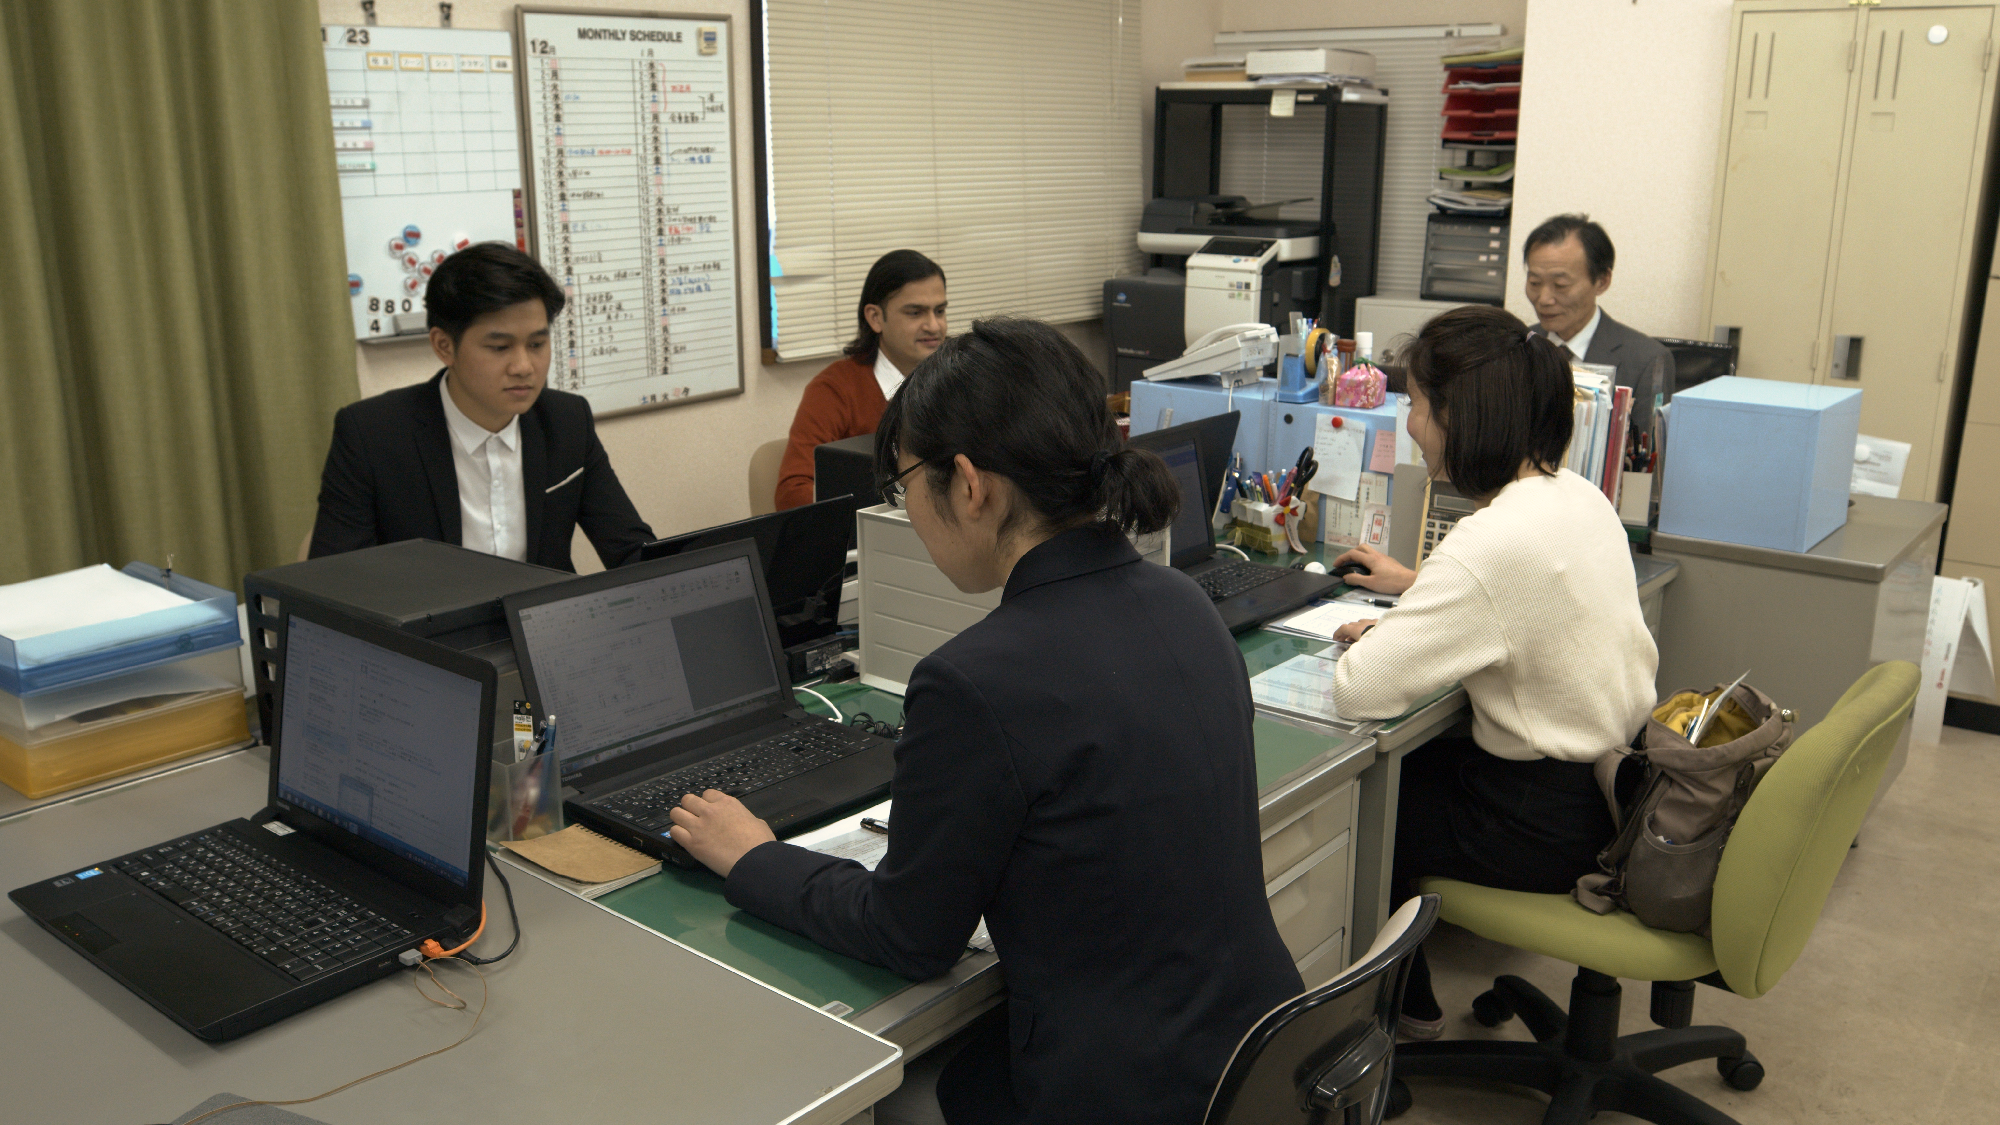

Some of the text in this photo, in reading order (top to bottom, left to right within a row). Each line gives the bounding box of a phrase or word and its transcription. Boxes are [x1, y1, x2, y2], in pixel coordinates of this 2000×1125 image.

[577, 28, 682, 43] MONTHLY SCHEDULE
[370, 319, 380, 332] 4
